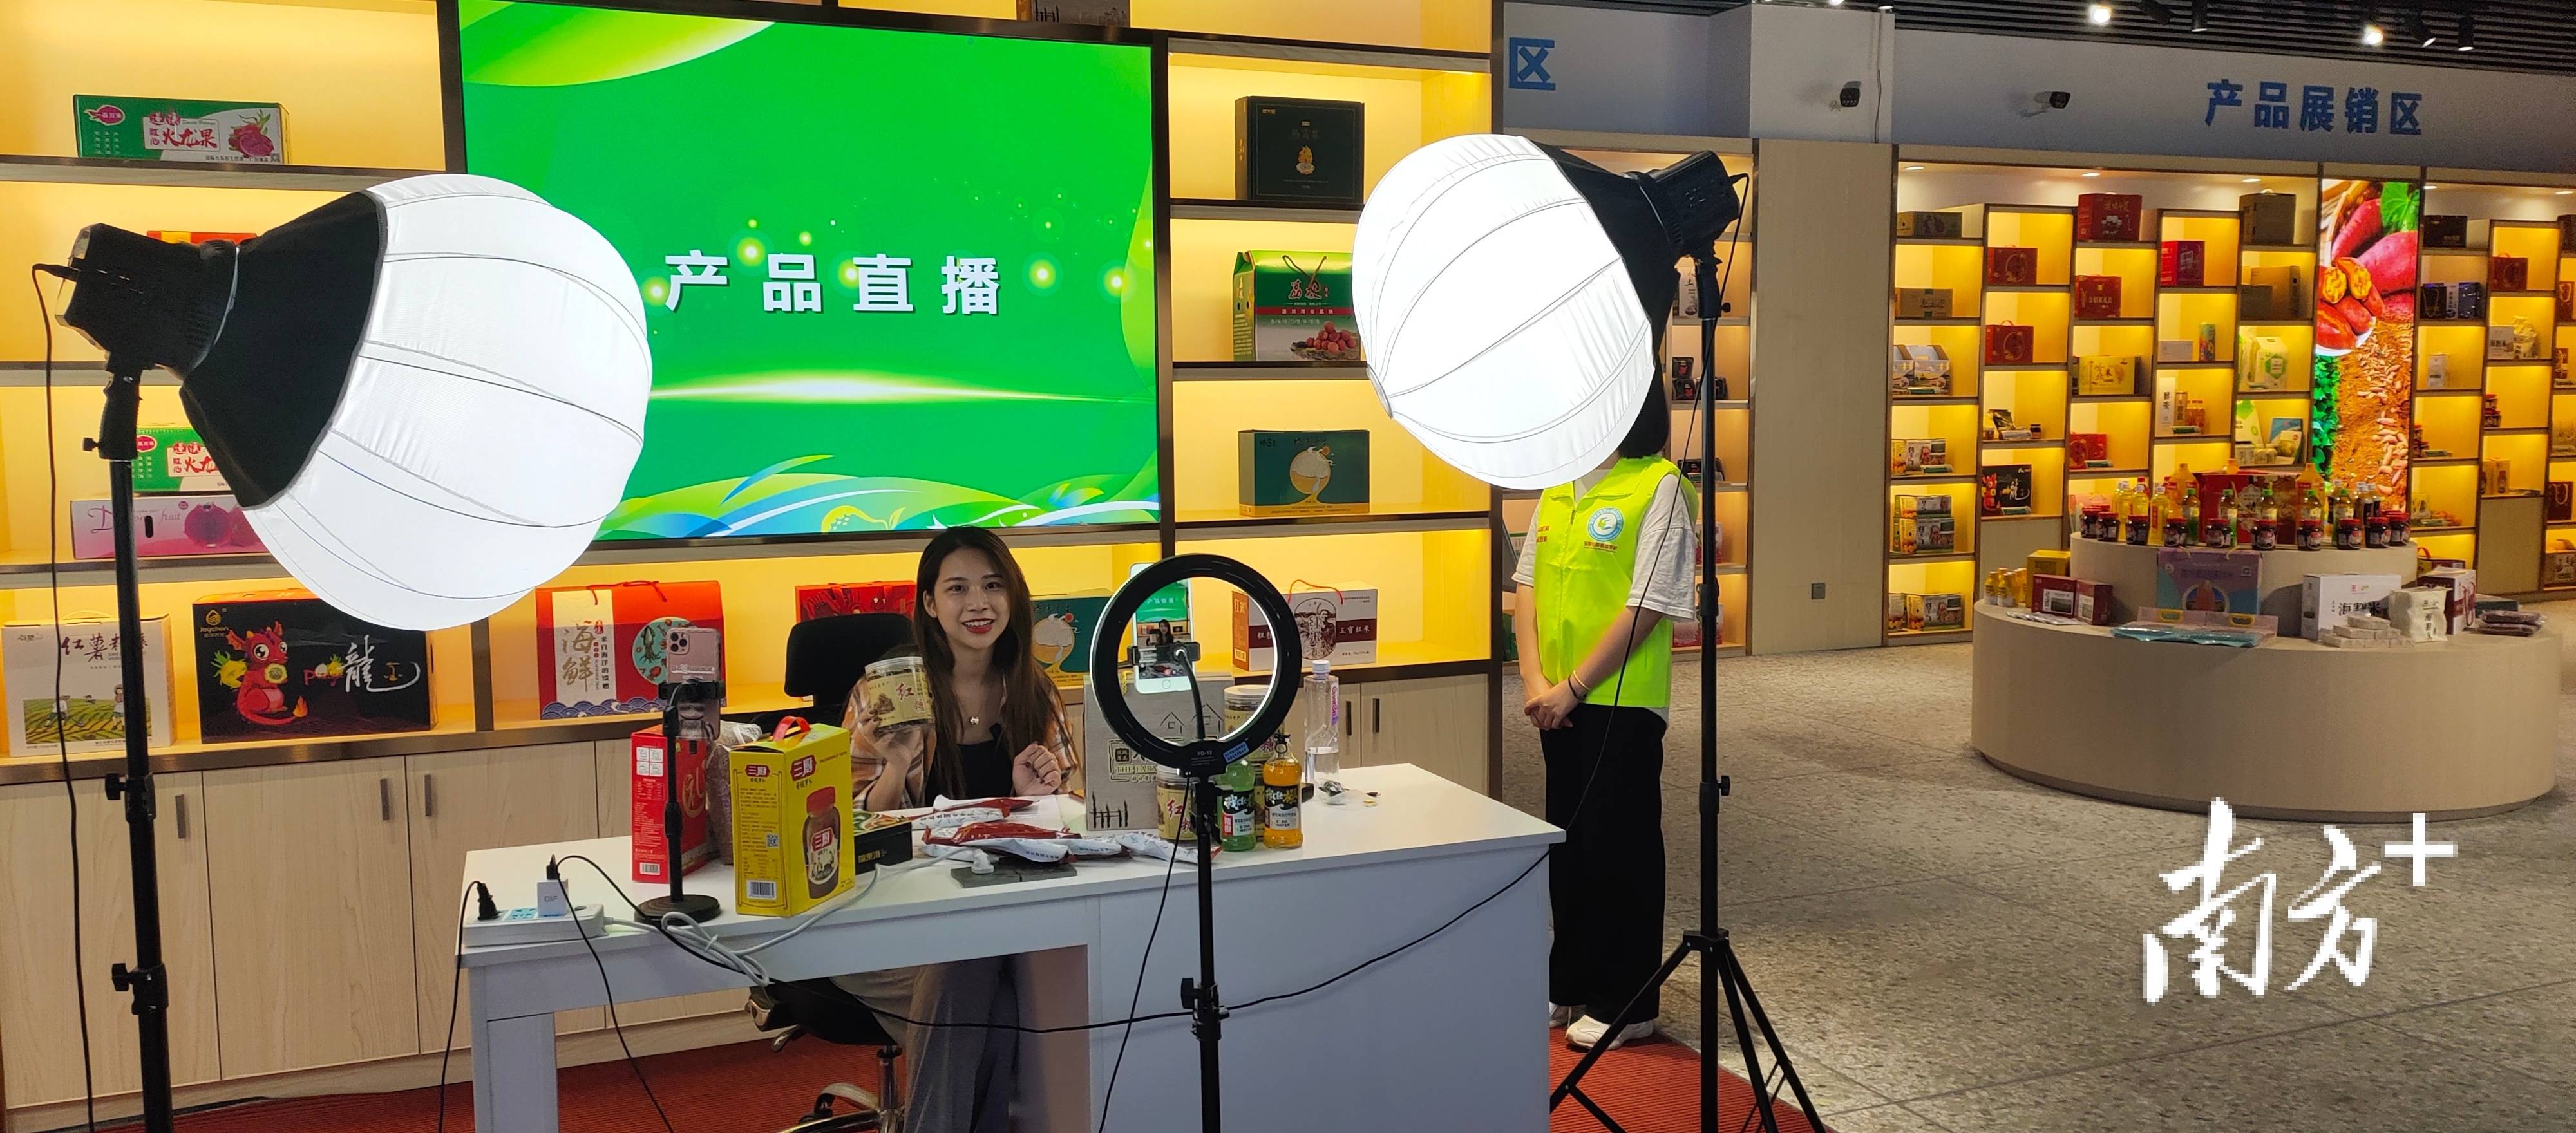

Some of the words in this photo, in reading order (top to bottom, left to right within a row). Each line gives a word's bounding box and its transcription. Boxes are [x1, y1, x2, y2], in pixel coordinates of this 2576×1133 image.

[1509, 37, 1556, 91] 区
[2205, 79, 2423, 135] 产品展销区
[161, 127, 218, 149] 火龙果
[665, 249, 999, 314] 产品直播
